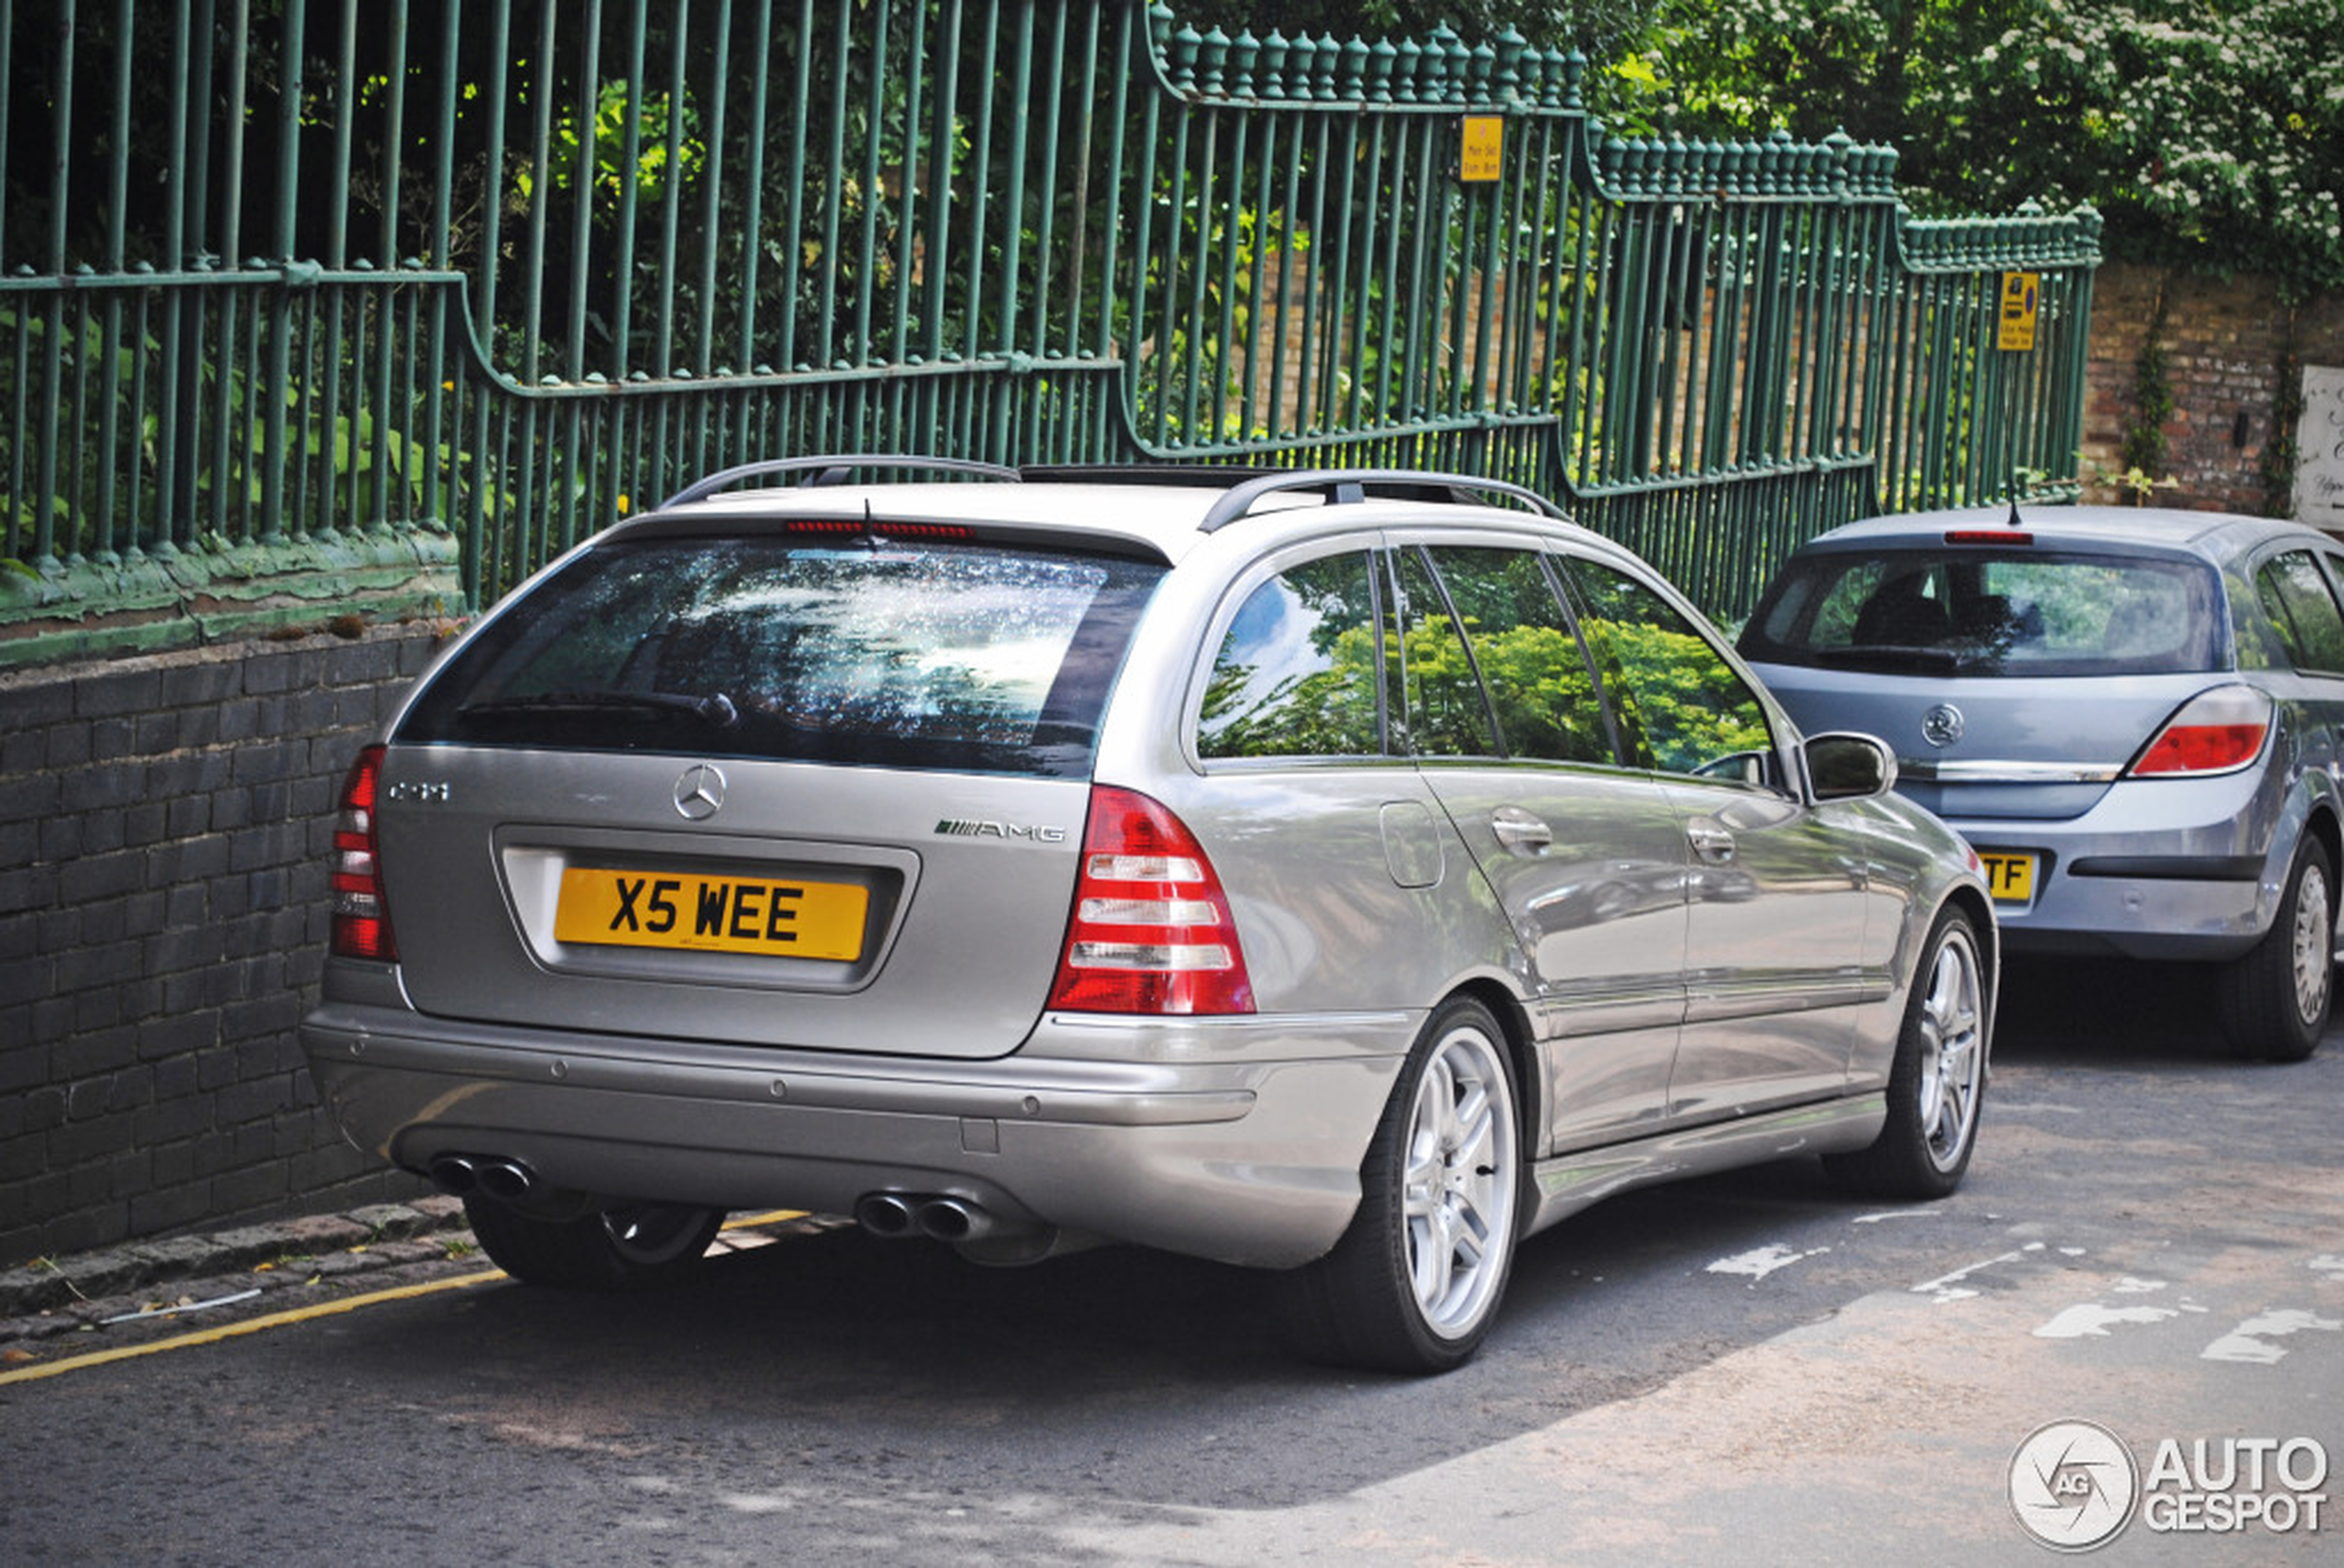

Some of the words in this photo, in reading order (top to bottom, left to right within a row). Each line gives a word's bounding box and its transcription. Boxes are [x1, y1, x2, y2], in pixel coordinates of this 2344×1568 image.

[978, 820, 1065, 844] AMG
[609, 879, 680, 933] X5
[695, 883, 804, 942] WEE
